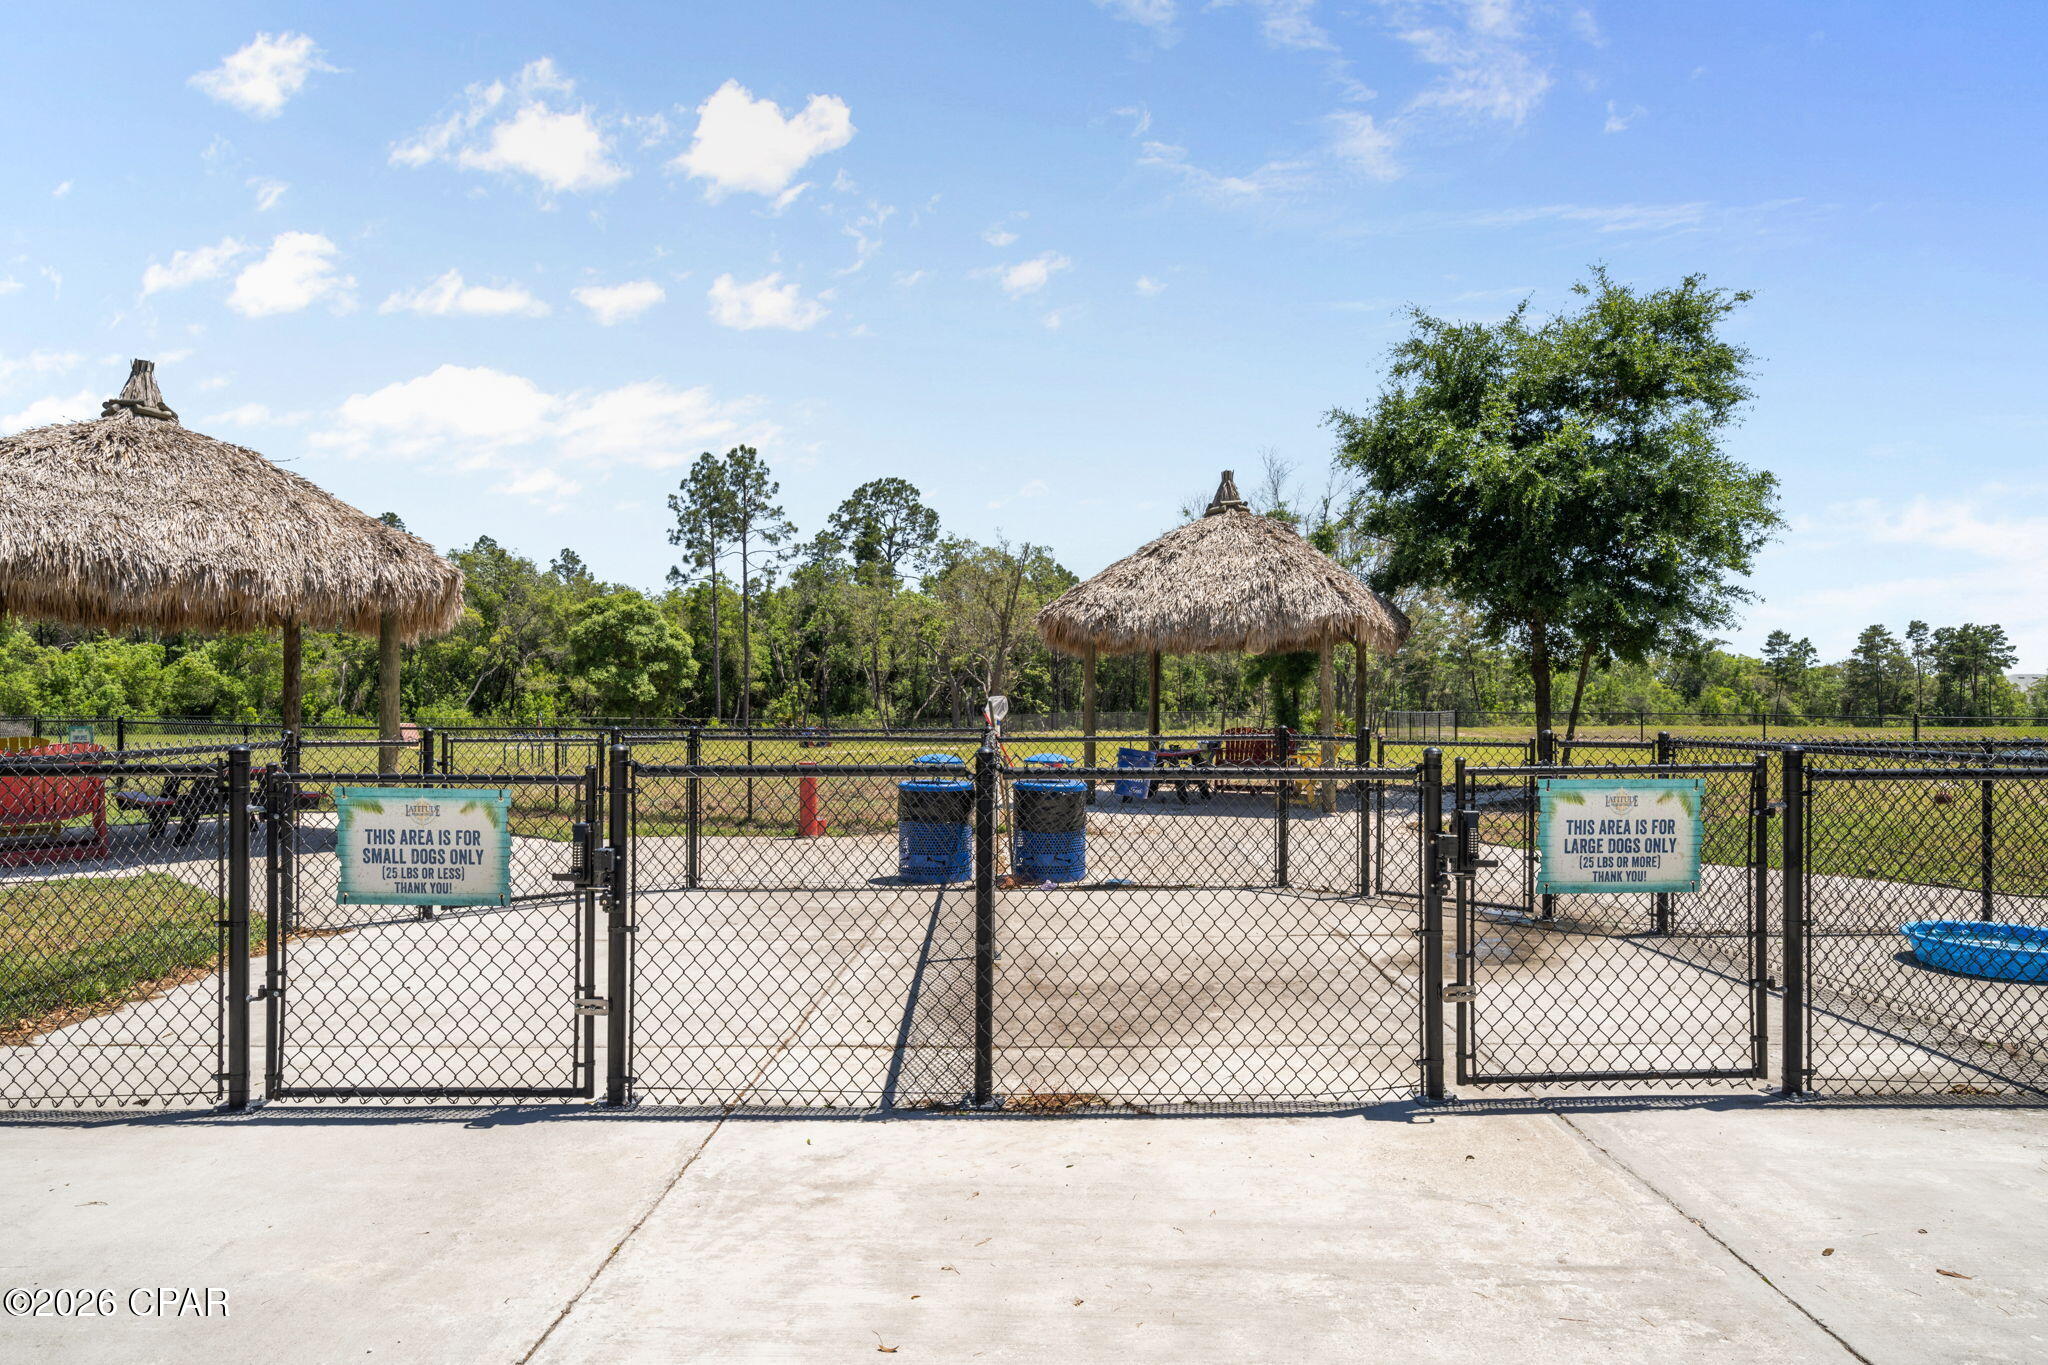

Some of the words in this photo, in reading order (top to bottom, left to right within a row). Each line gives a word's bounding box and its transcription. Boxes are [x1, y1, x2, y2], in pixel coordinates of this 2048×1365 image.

[1566, 819, 1595, 835] THIS
[1599, 819, 1631, 835] AREA
[1635, 819, 1647, 835] IS
[1651, 819, 1675, 834] FOR
[365, 828, 395, 845] THIS
[400, 829, 434, 845] AREA
[438, 830, 451, 846] IS
[456, 830, 480, 846] FOR
[1564, 838, 1603, 854] LARGE
[1608, 838, 1641, 854] DOGS
[1644, 838, 1677, 853] ONLY
[362, 848, 406, 864] SMALL
[411, 848, 445, 865] DOGS
[450, 849, 484, 865] ONLY
[1579, 855, 1594, 870] (25
[1597, 856, 1614, 868] LBS
[1616, 856, 1629, 868] OR
[1631, 855, 1661, 869] MORE)
[382, 865, 398, 880] (25
[401, 867, 419, 879] LBS
[421, 867, 434, 879] OR
[437, 866, 465, 881] LESS)
[1592, 871, 1623, 882] THANK
[1625, 871, 1647, 882] YOU!
[394, 881, 427, 894] THANK
[429, 882, 452, 894] YOU!
